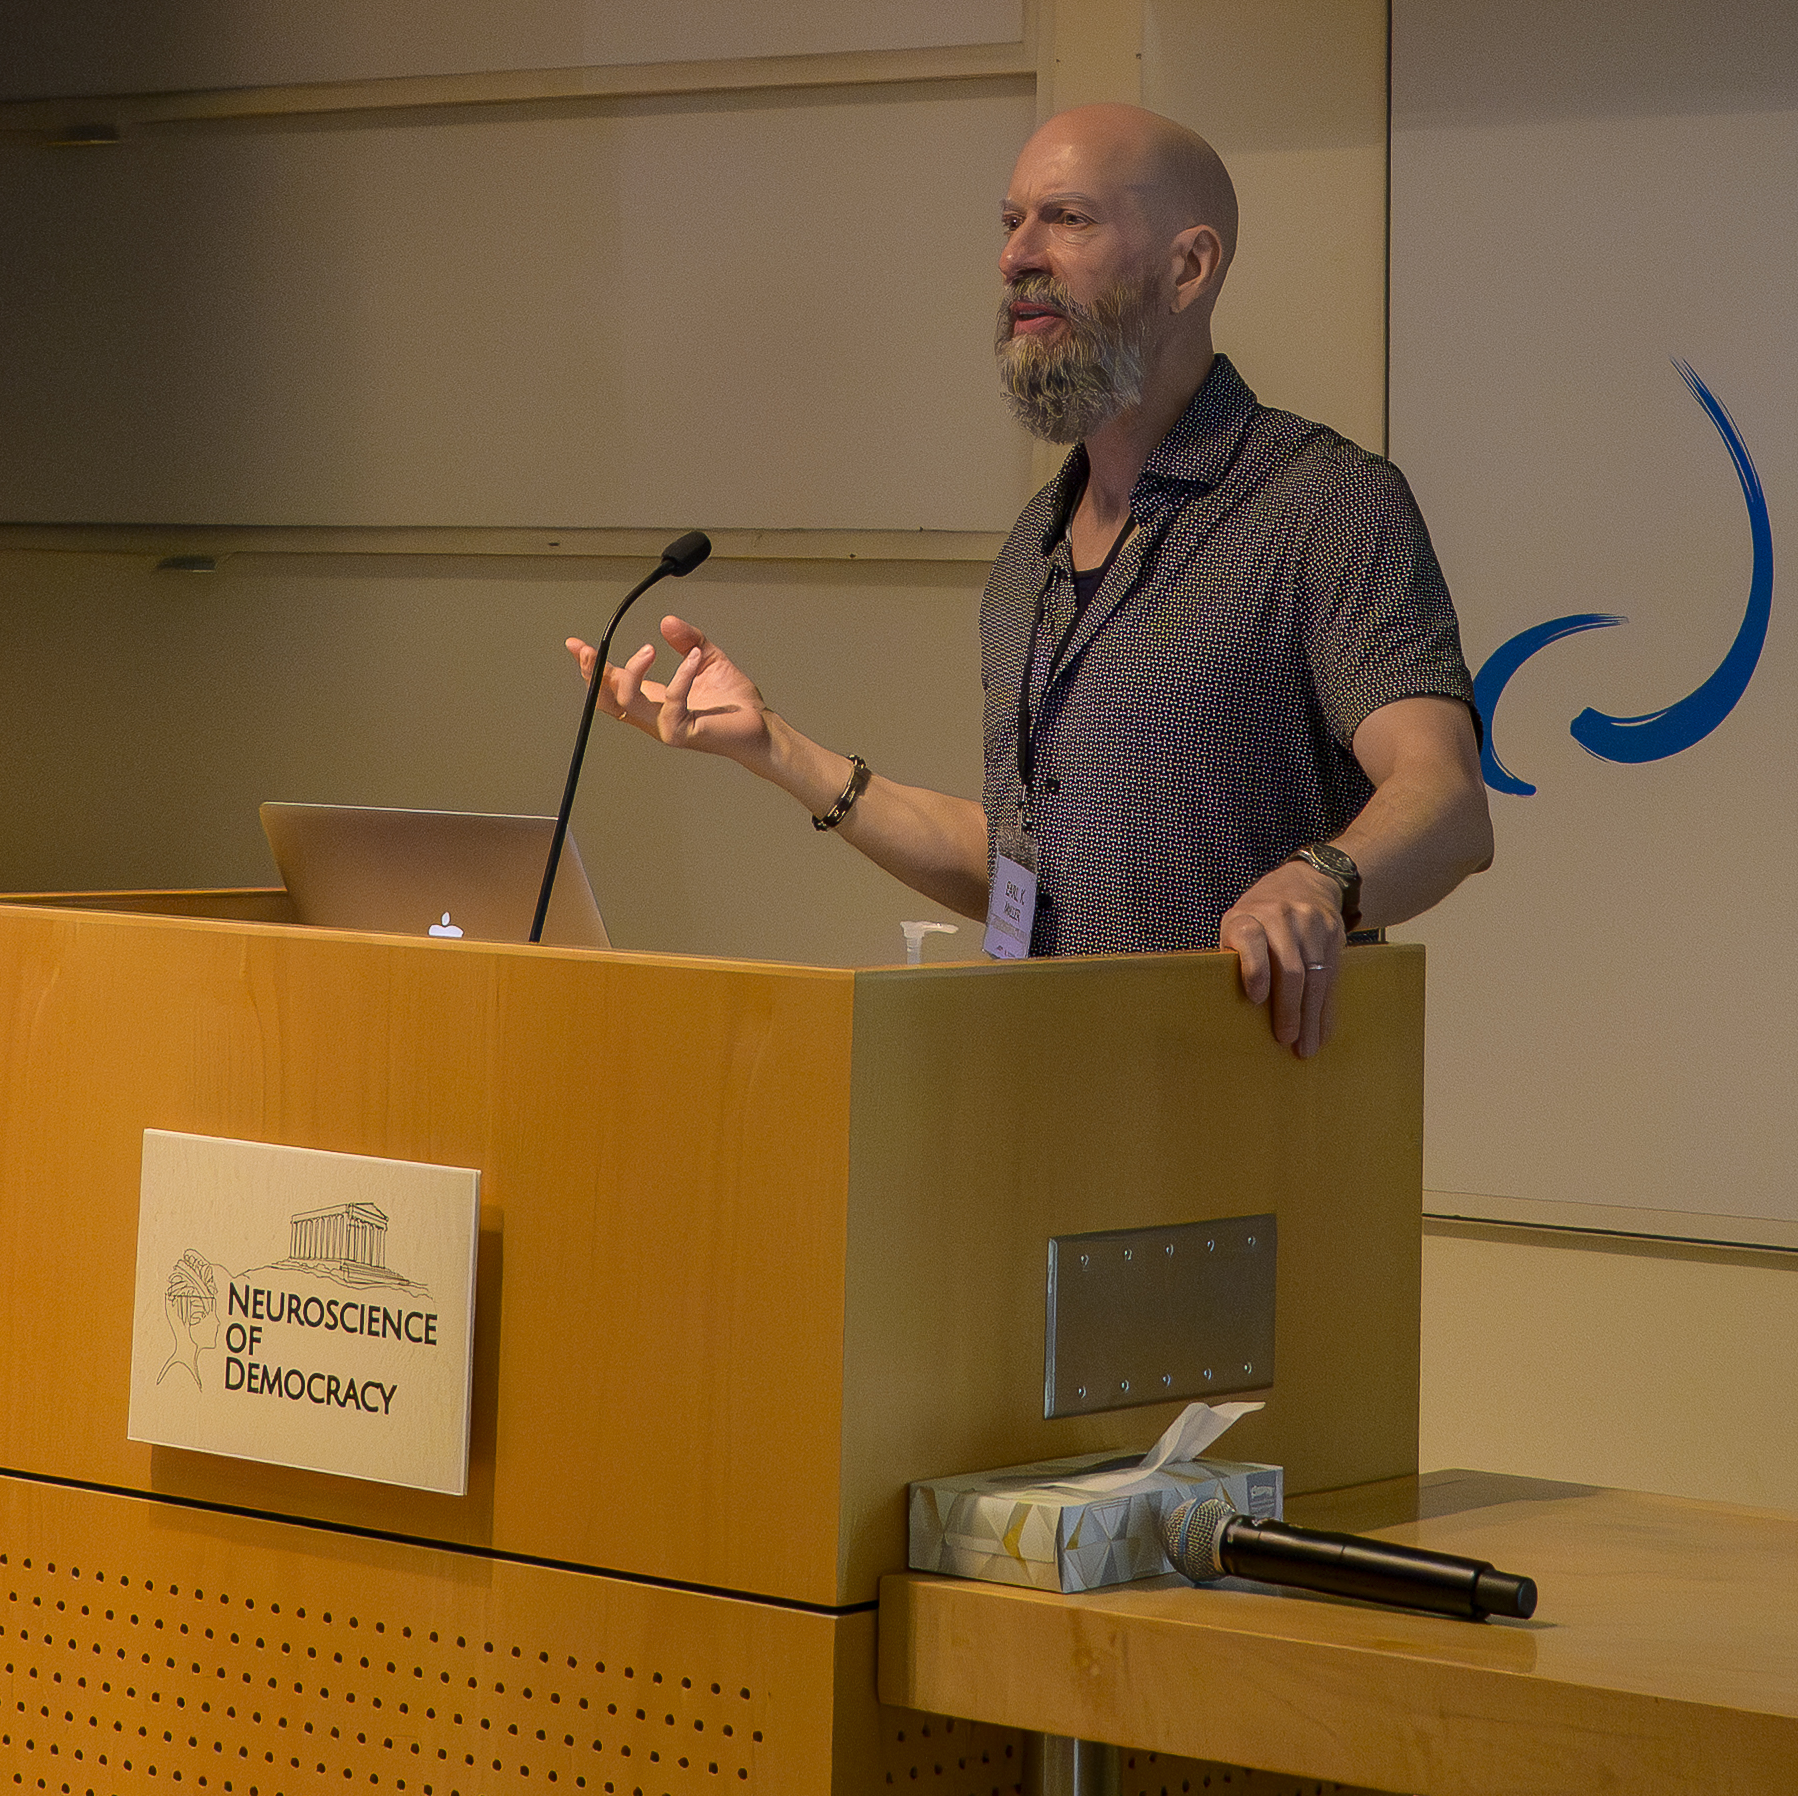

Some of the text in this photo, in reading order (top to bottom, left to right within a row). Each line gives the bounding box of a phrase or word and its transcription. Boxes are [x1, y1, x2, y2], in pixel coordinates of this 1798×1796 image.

[226, 1323, 262, 1355] OF
[228, 1282, 438, 1346] NEUROSCIENCE
[224, 1357, 397, 1415] DEMOCRACY
